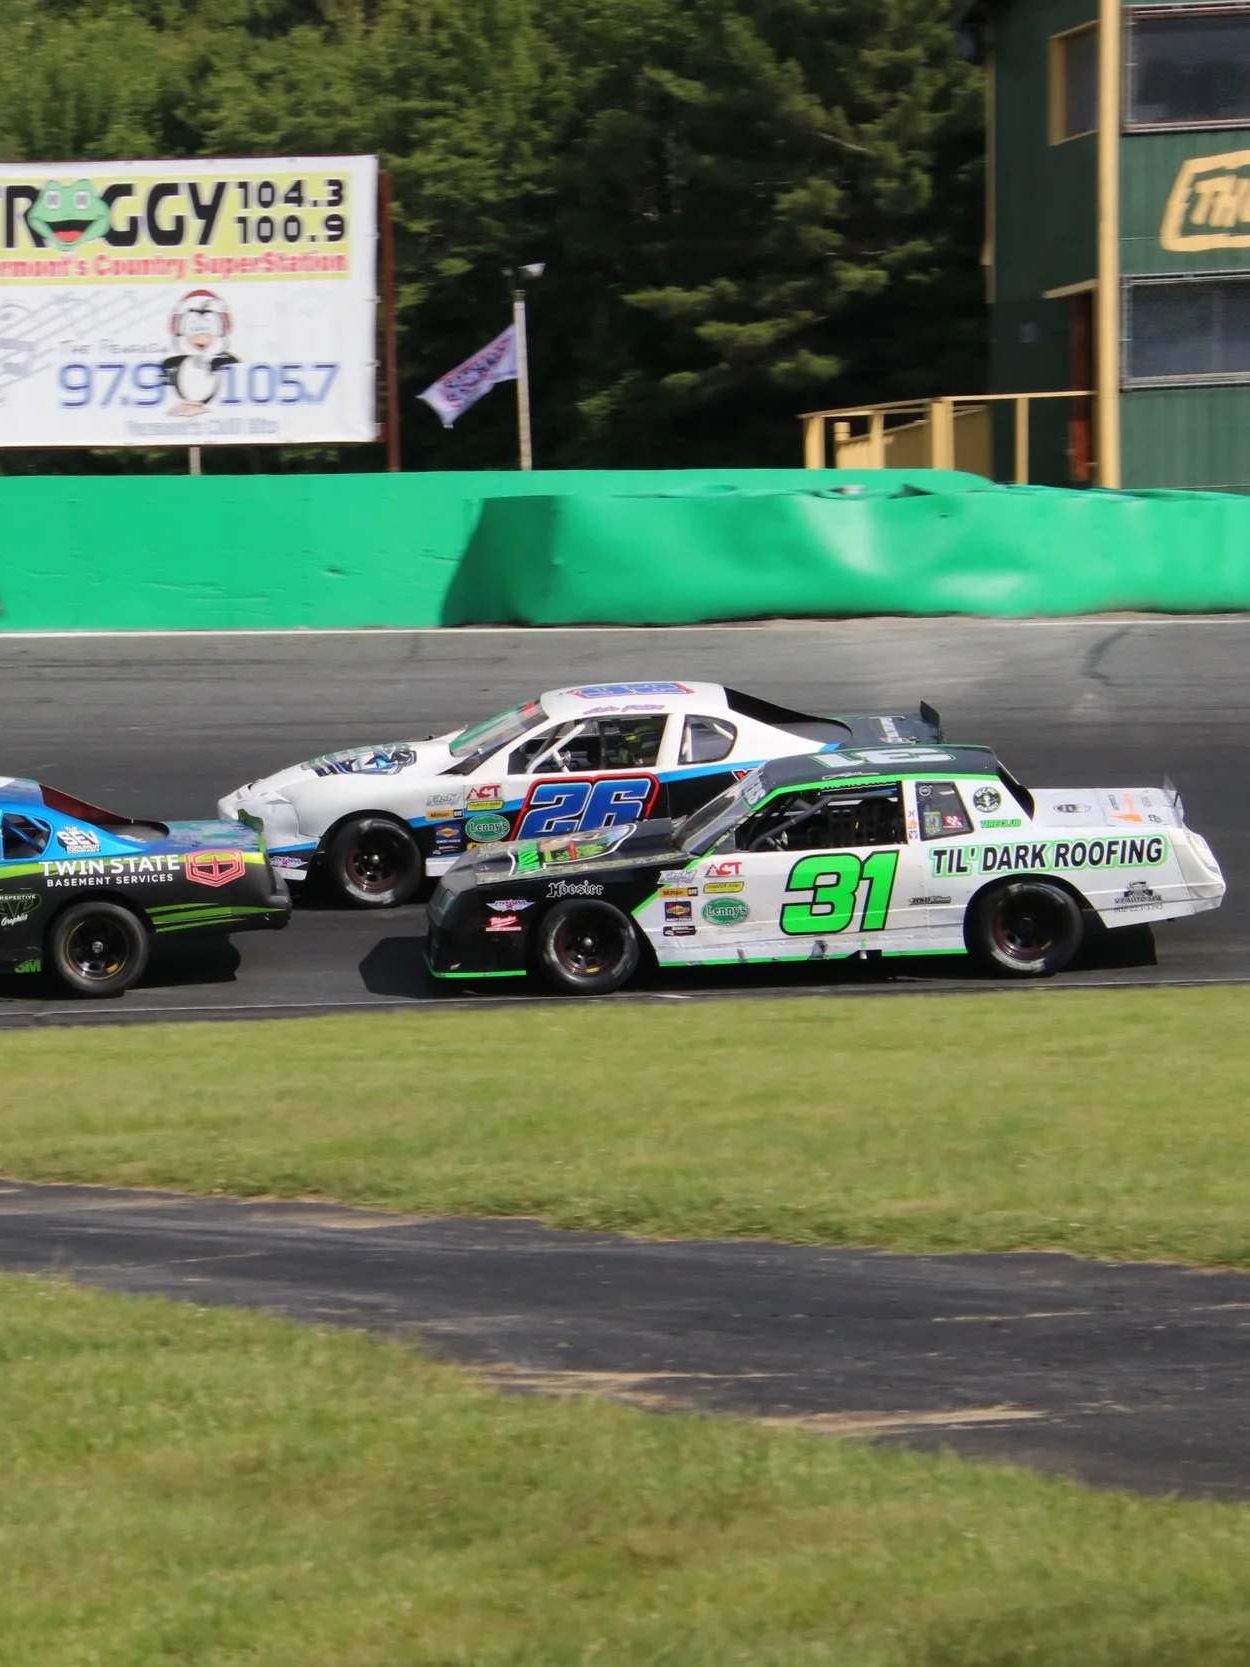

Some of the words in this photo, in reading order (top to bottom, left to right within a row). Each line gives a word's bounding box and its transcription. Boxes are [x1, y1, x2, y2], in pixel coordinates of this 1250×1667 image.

[234, 178, 344, 210] 104.3
[1191, 173, 1250, 228] TH
[234, 214, 345, 244] 100.9
[94, 254, 187, 281] Country
[192, 250, 348, 279] SuperStation
[59, 361, 166, 408] 97.9
[220, 361, 341, 406] 105.7
[465, 785, 501, 800] ACT
[517, 777, 653, 841] 26
[470, 822, 507, 833] Lenny's
[38, 858, 105, 877] TWIN
[110, 854, 181, 875] STATE
[705, 861, 742, 876] ACT
[932, 847, 976, 874] TIL'
[981, 843, 1048, 872] DARK
[1053, 837, 1163, 868] ROOFING
[46, 876, 111, 887] BASEMENT
[116, 873, 174, 884] SERVICES
[546, 880, 604, 898] Hoosier
[780, 850, 900, 936] 31
[706, 906, 747, 917] Lenny's
